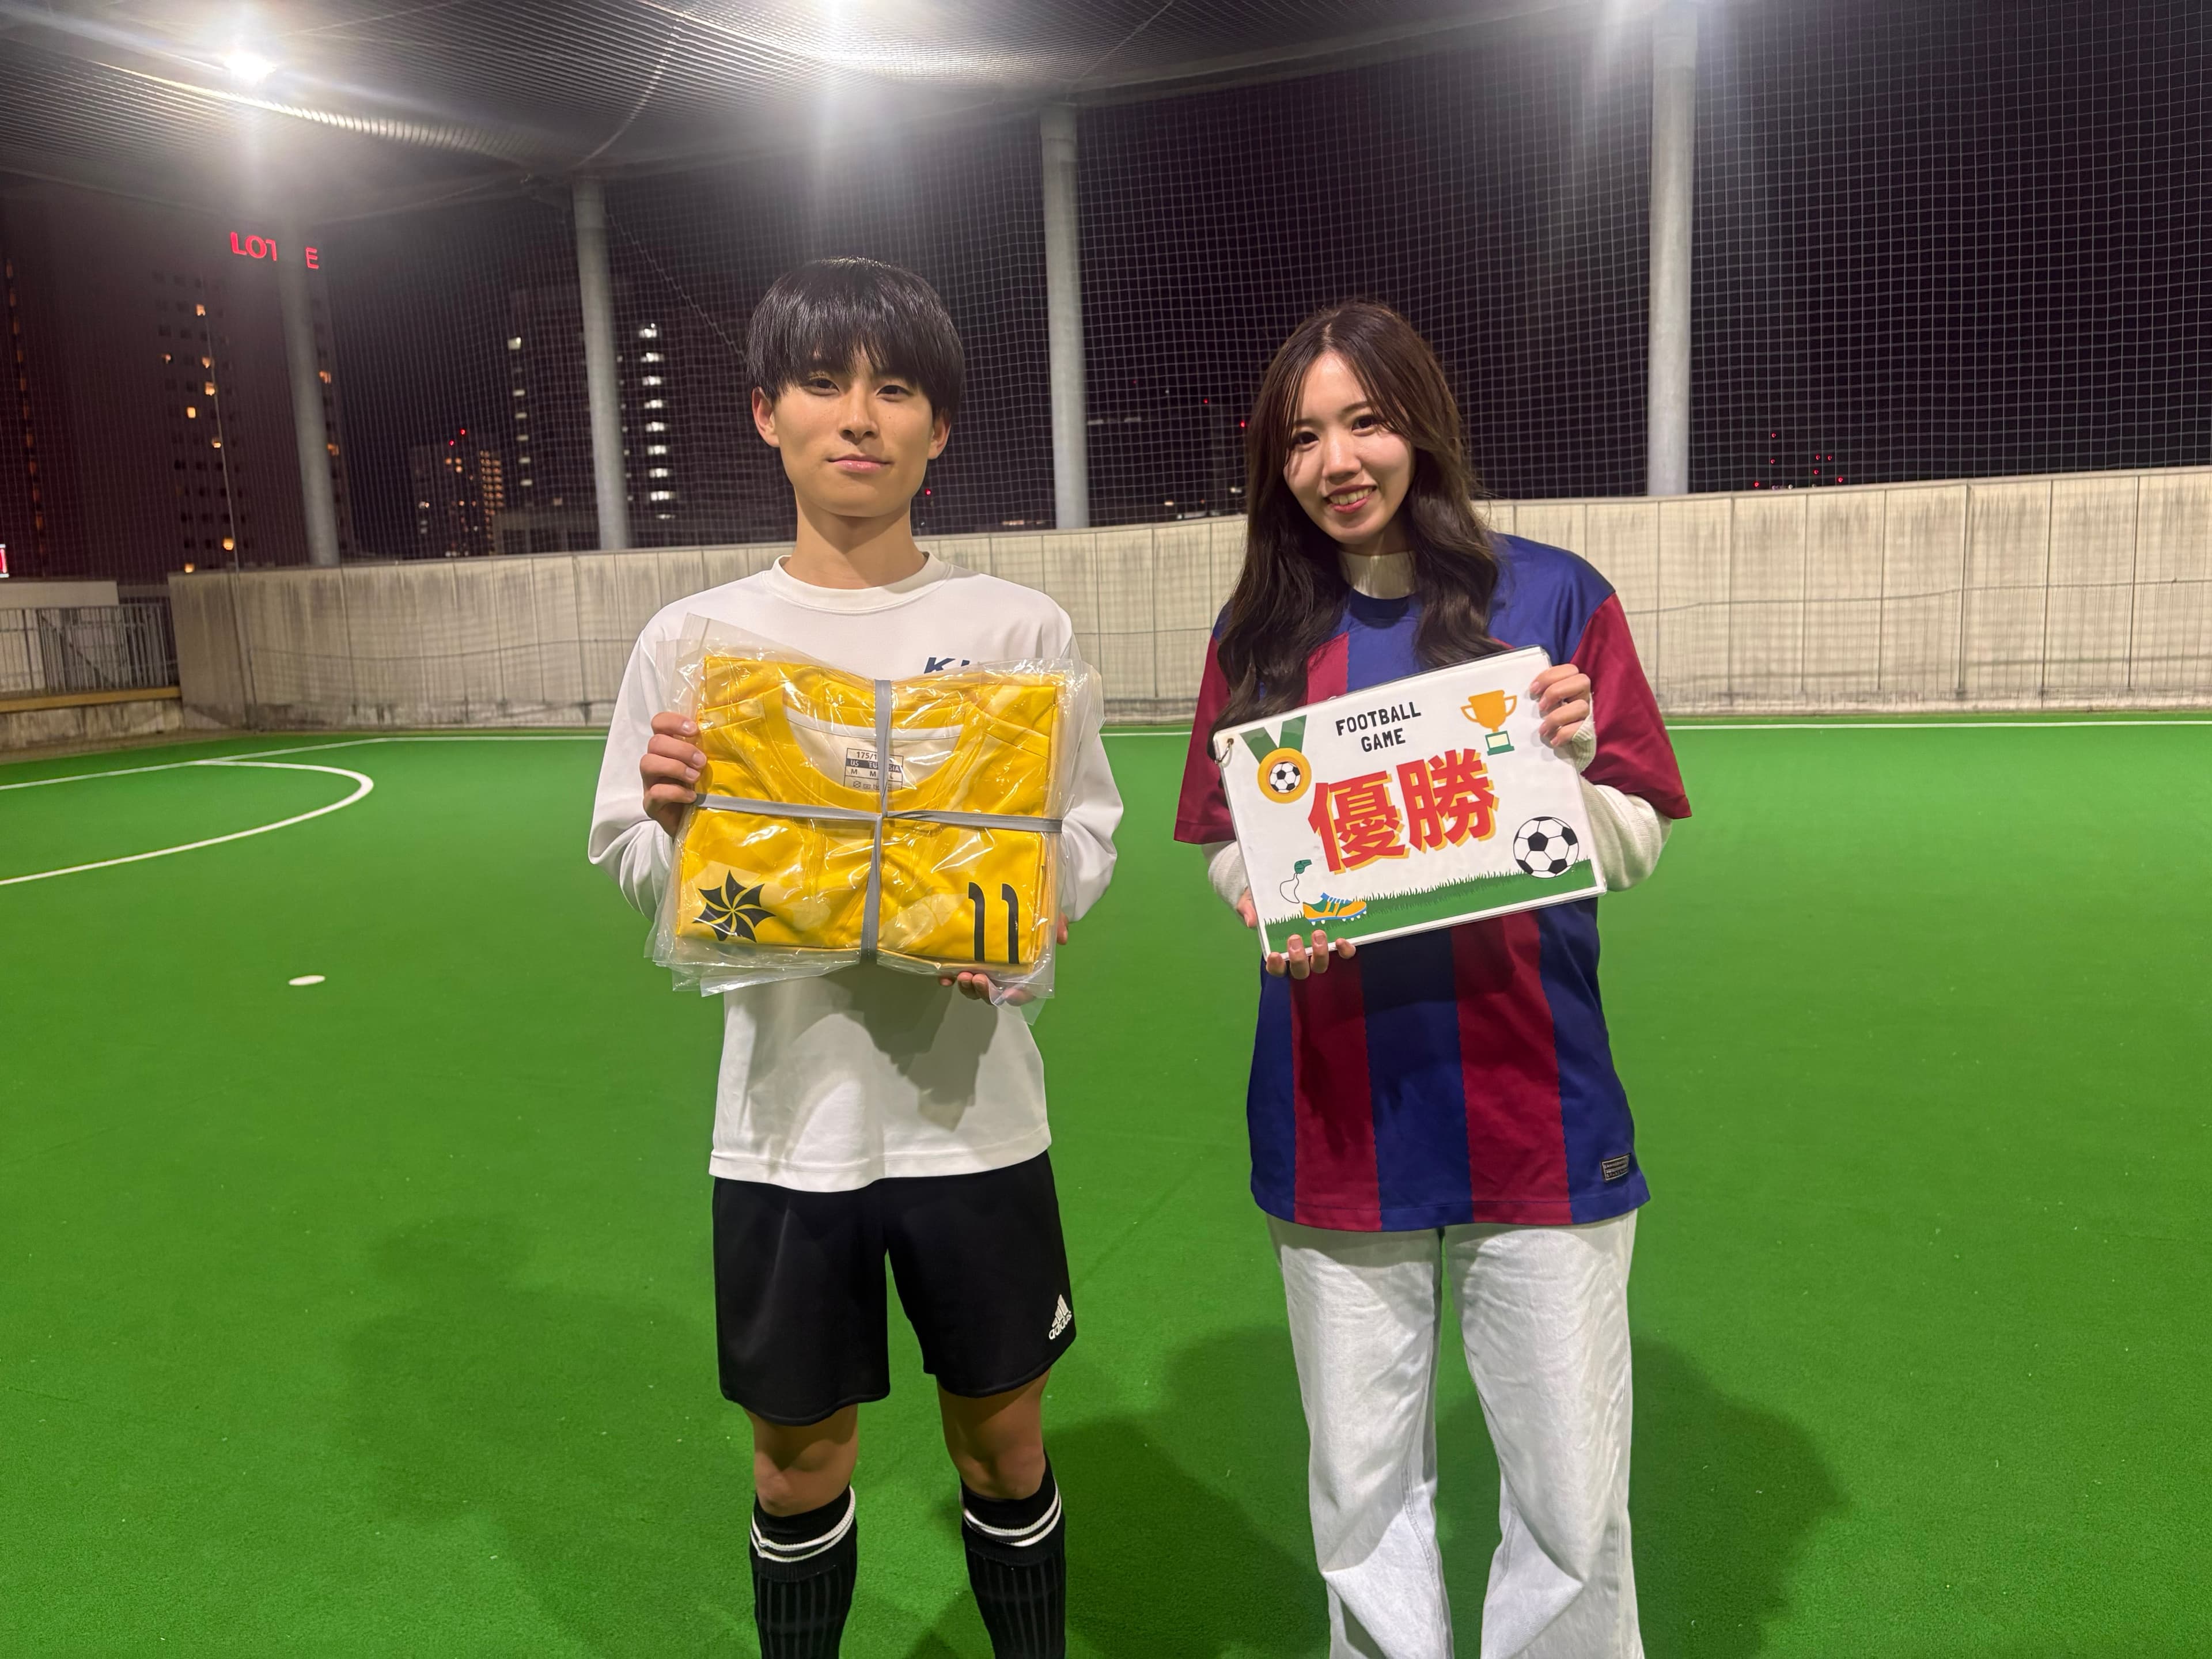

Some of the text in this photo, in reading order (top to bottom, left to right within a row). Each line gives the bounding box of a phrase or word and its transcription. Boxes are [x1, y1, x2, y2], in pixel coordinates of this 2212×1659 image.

[230, 231, 319, 269] LOTE
[1335, 702, 1422, 736] FOOTBALL
[1361, 728, 1406, 752] GAME
[1308, 748, 1499, 875] 優勝
[968, 881, 1020, 964] 11
